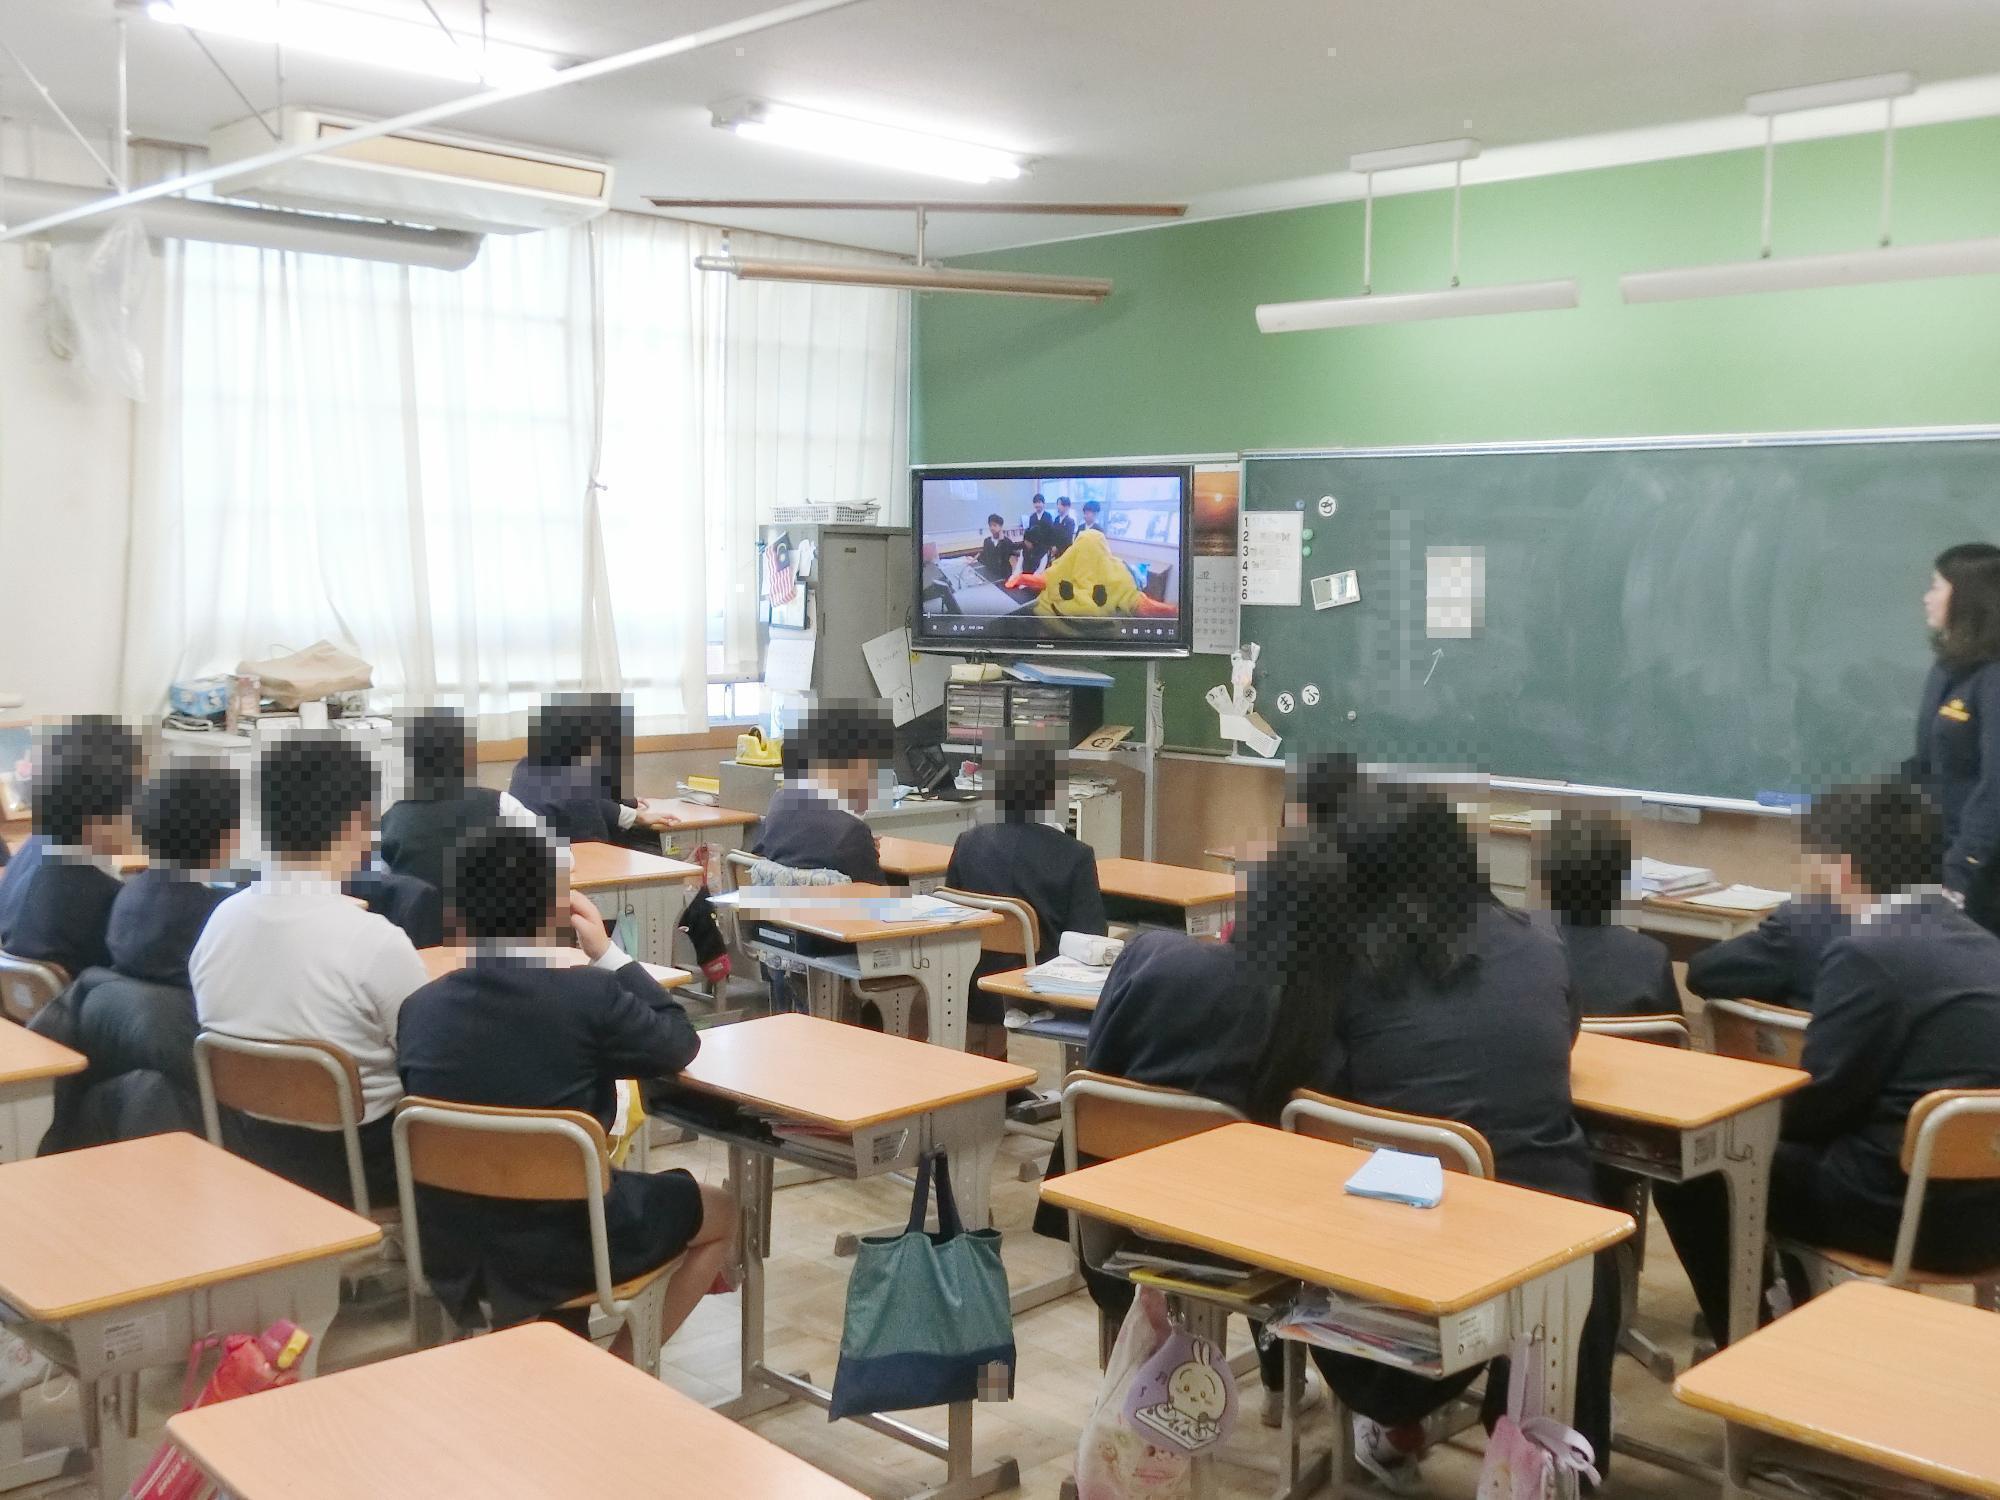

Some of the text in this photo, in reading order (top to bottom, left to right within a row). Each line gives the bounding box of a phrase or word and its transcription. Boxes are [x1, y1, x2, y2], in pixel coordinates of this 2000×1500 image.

[1244, 517, 1249, 527] 1
[1243, 531, 1249, 541] 2
[1242, 546, 1249, 556] 3
[1242, 561, 1249, 571] 4
[1241, 576, 1248, 586] 5
[1241, 589, 1248, 600] 6
